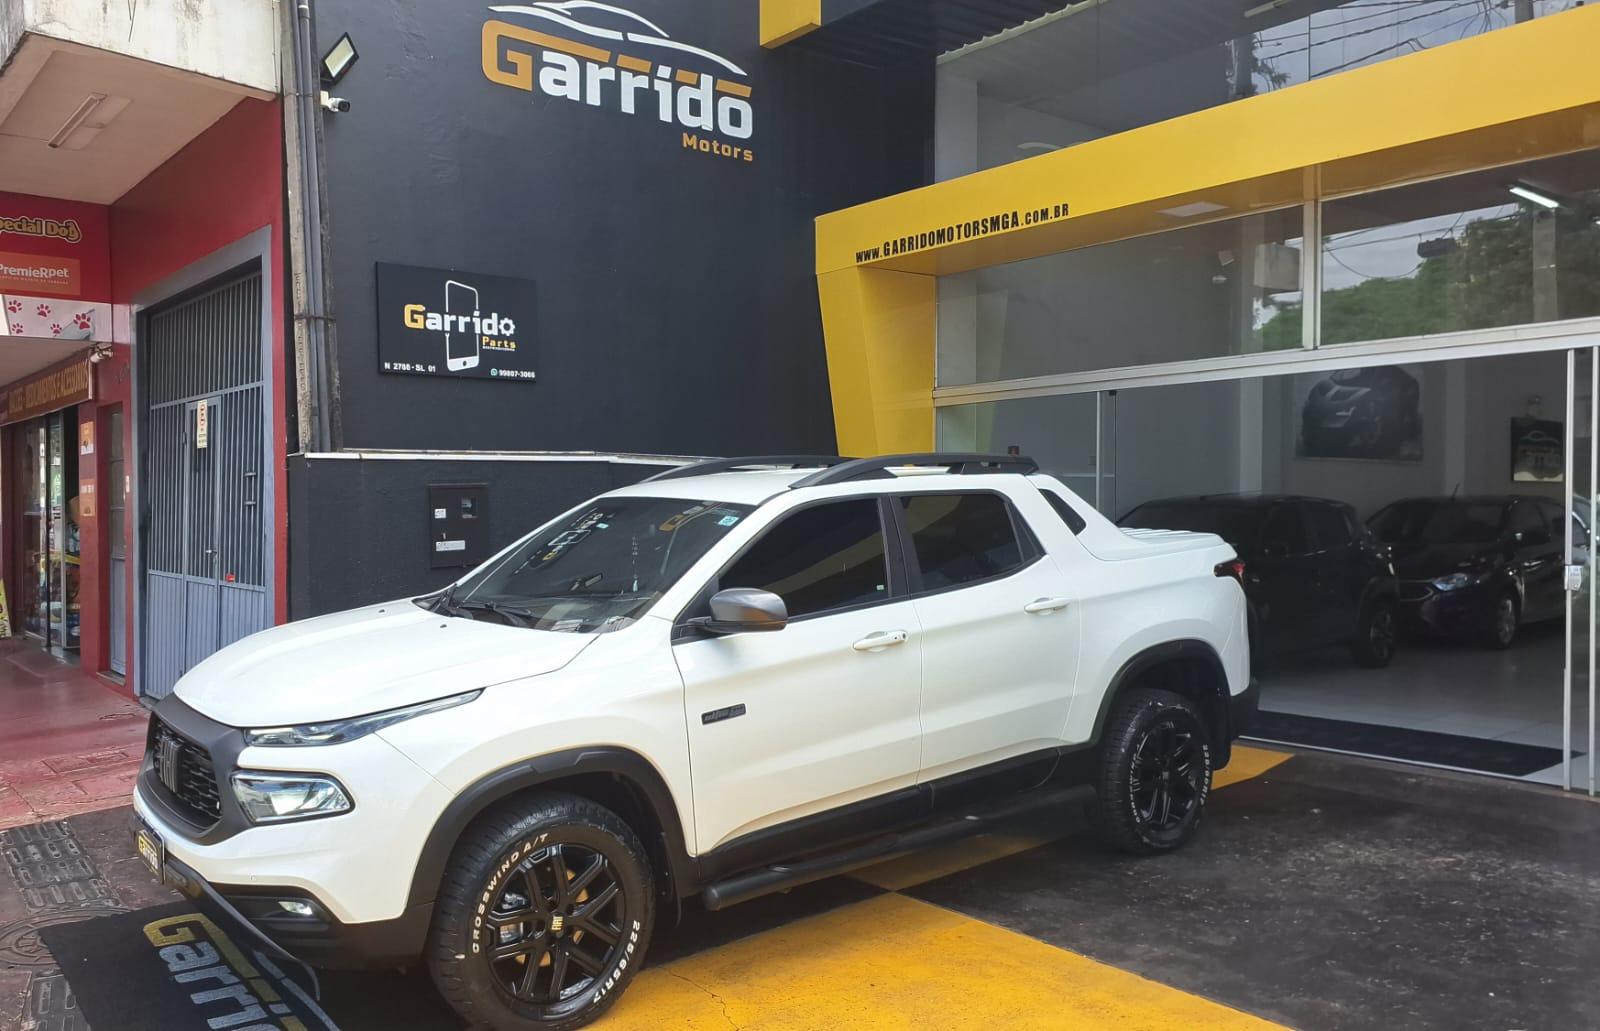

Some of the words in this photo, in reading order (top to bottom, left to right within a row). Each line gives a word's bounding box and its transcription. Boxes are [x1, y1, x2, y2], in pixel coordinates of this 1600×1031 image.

[481, 19, 753, 139] Garrido
[682, 132, 753, 162] Motors
[46, 221, 79, 241] Dog
[404, 304, 516, 337] Garrido
[482, 335, 517, 349] Parts
[472, 851, 520, 954] CROSSWIND
[523, 833, 549, 853] A/T
[593, 919, 641, 1003] 225/65R17
